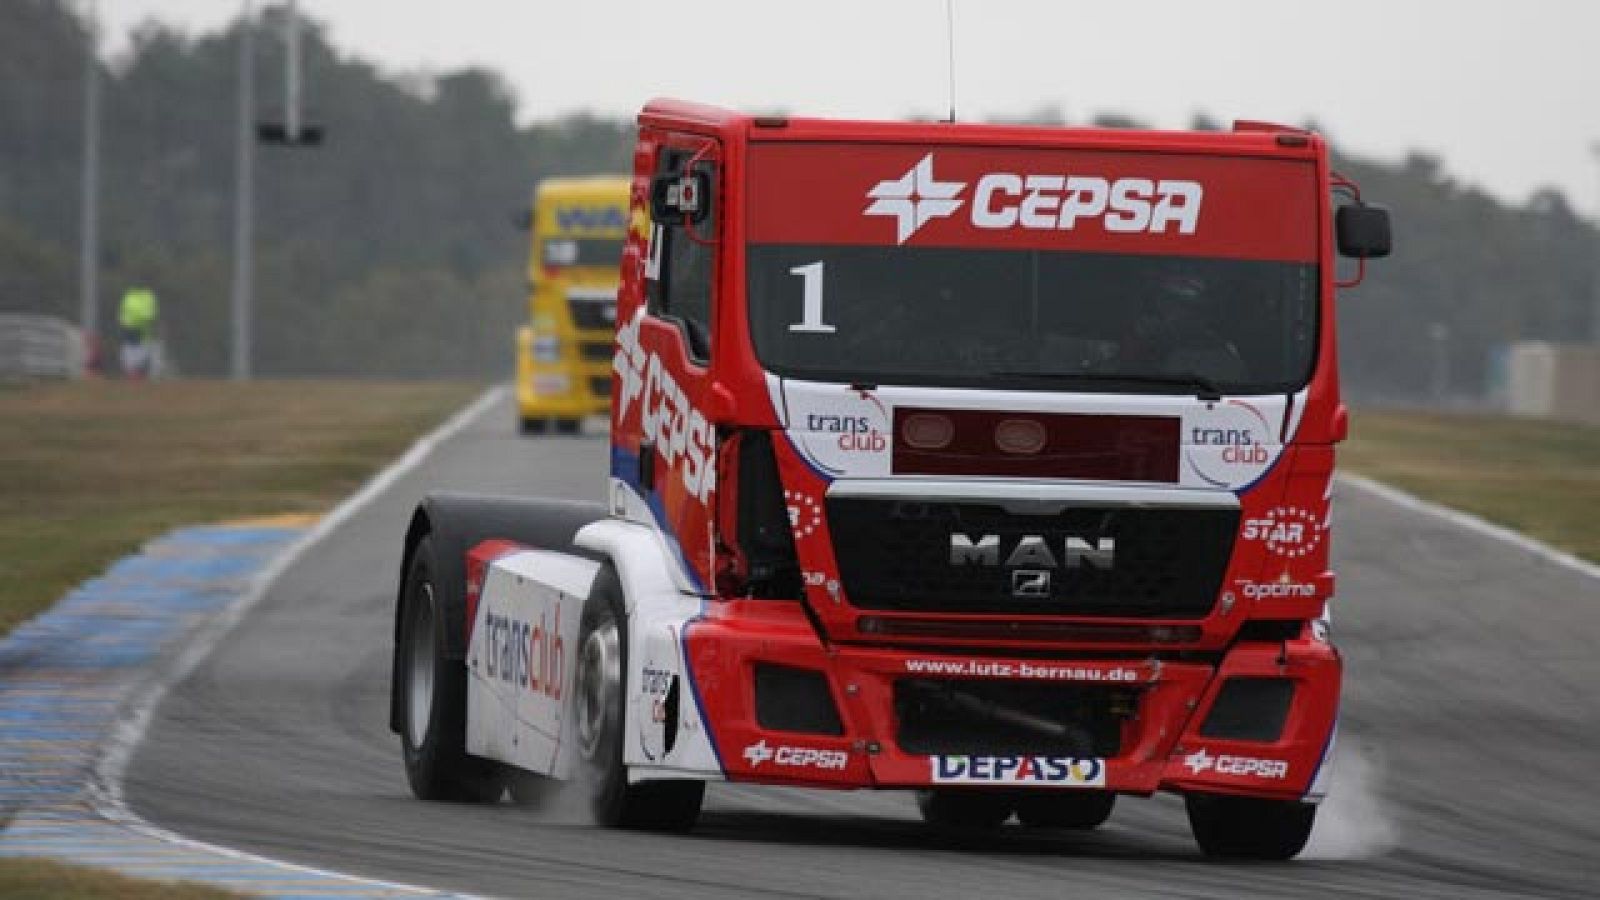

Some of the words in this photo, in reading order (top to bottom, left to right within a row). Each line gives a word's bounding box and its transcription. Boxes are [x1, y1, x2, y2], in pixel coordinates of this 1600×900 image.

[971, 172, 1203, 235] CEPSA
[789, 260, 837, 335] 1
[807, 413, 869, 433] trans
[838, 427, 886, 453] club
[1192, 427, 1251, 446] trans
[1222, 443, 1269, 464] club
[1242, 519, 1304, 542] STAR
[951, 534, 1116, 570] MAN
[905, 659, 1138, 682] www.lutz-bernau.de
[774, 745, 848, 771] CEPSA
[937, 755, 1106, 781] DEPASO
[1215, 754, 1289, 780] CEPSA
